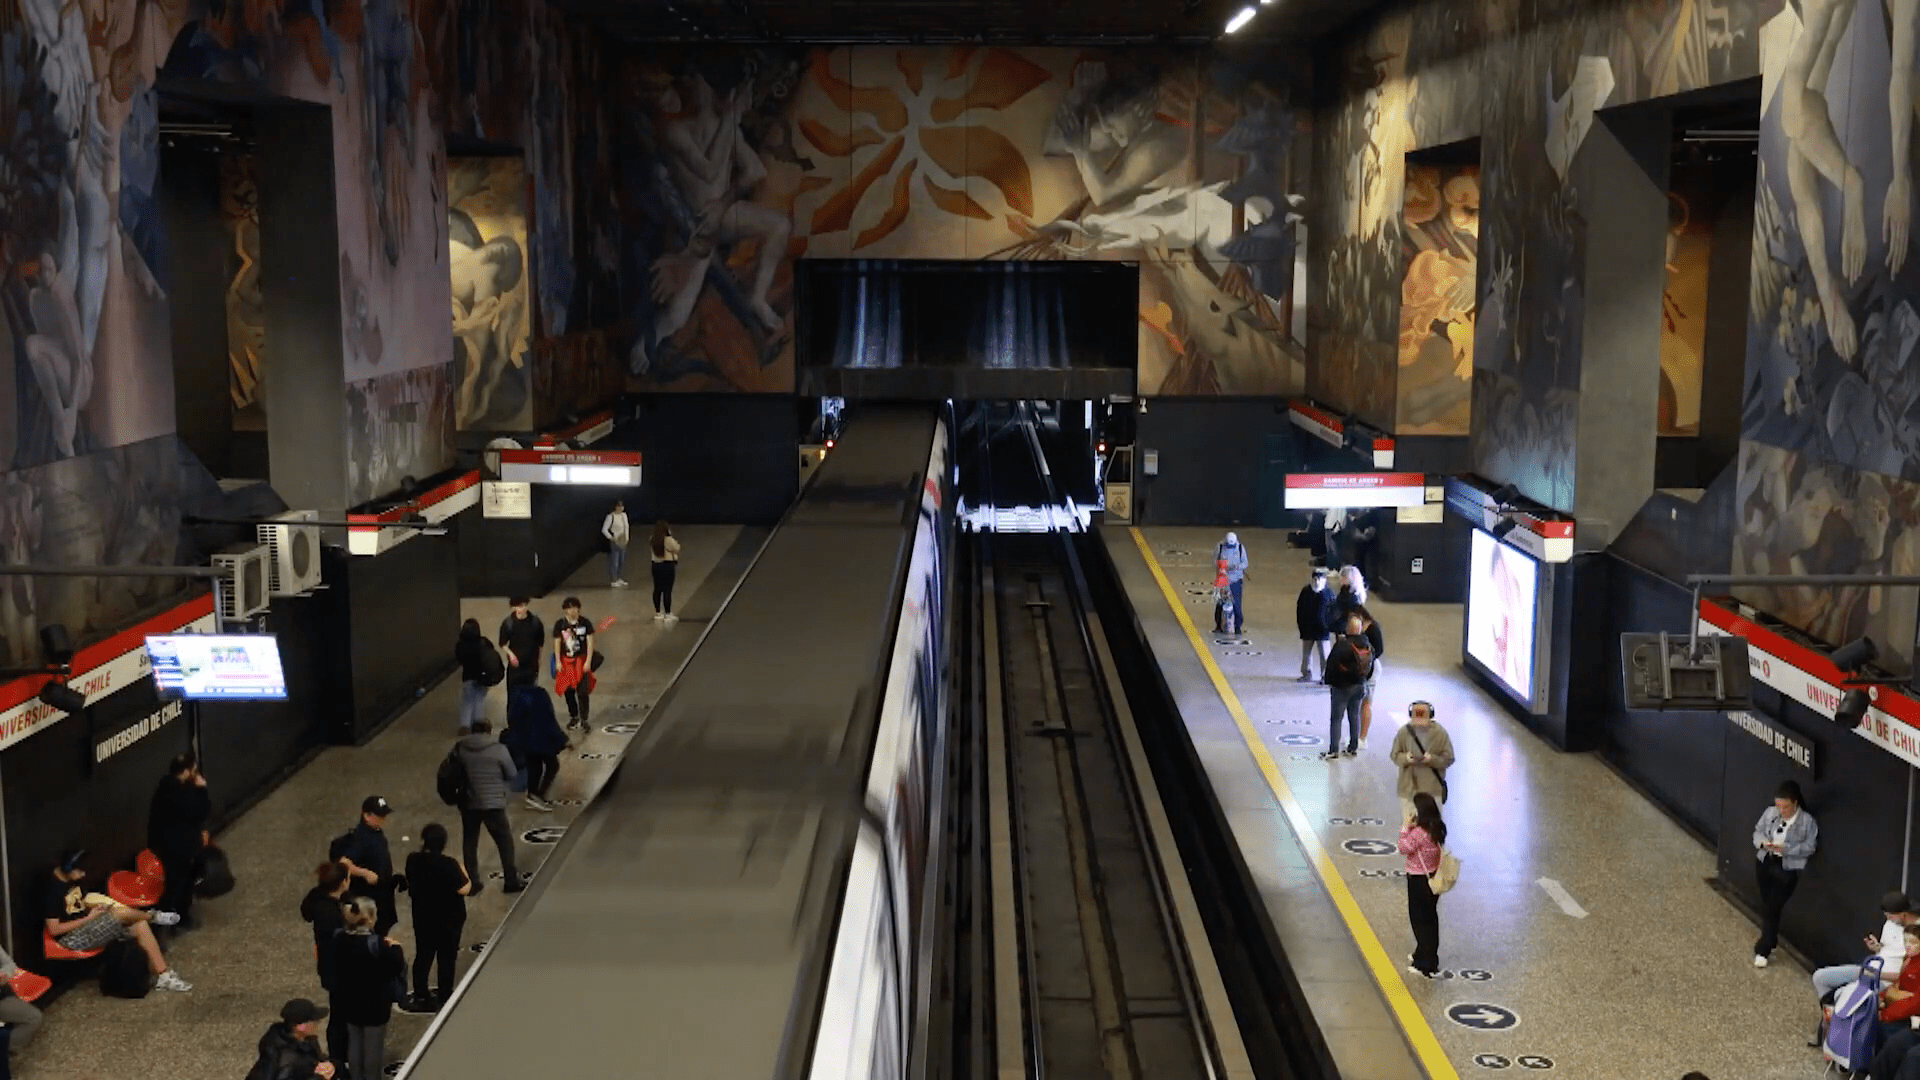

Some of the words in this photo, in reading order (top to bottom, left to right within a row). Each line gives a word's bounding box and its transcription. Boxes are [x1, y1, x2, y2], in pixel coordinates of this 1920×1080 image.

[84, 670, 112, 697] CHILE
[96, 718, 149, 763] UNIVERSIDAD
[150, 710, 161, 732] DE
[162, 700, 182, 725] CHILE
[1727, 711, 1774, 745] UNIVERSIDAD
[1774, 731, 1785, 754] DE
[1786, 738, 1810, 768] CHILE
[1876, 719, 1889, 742] DE
